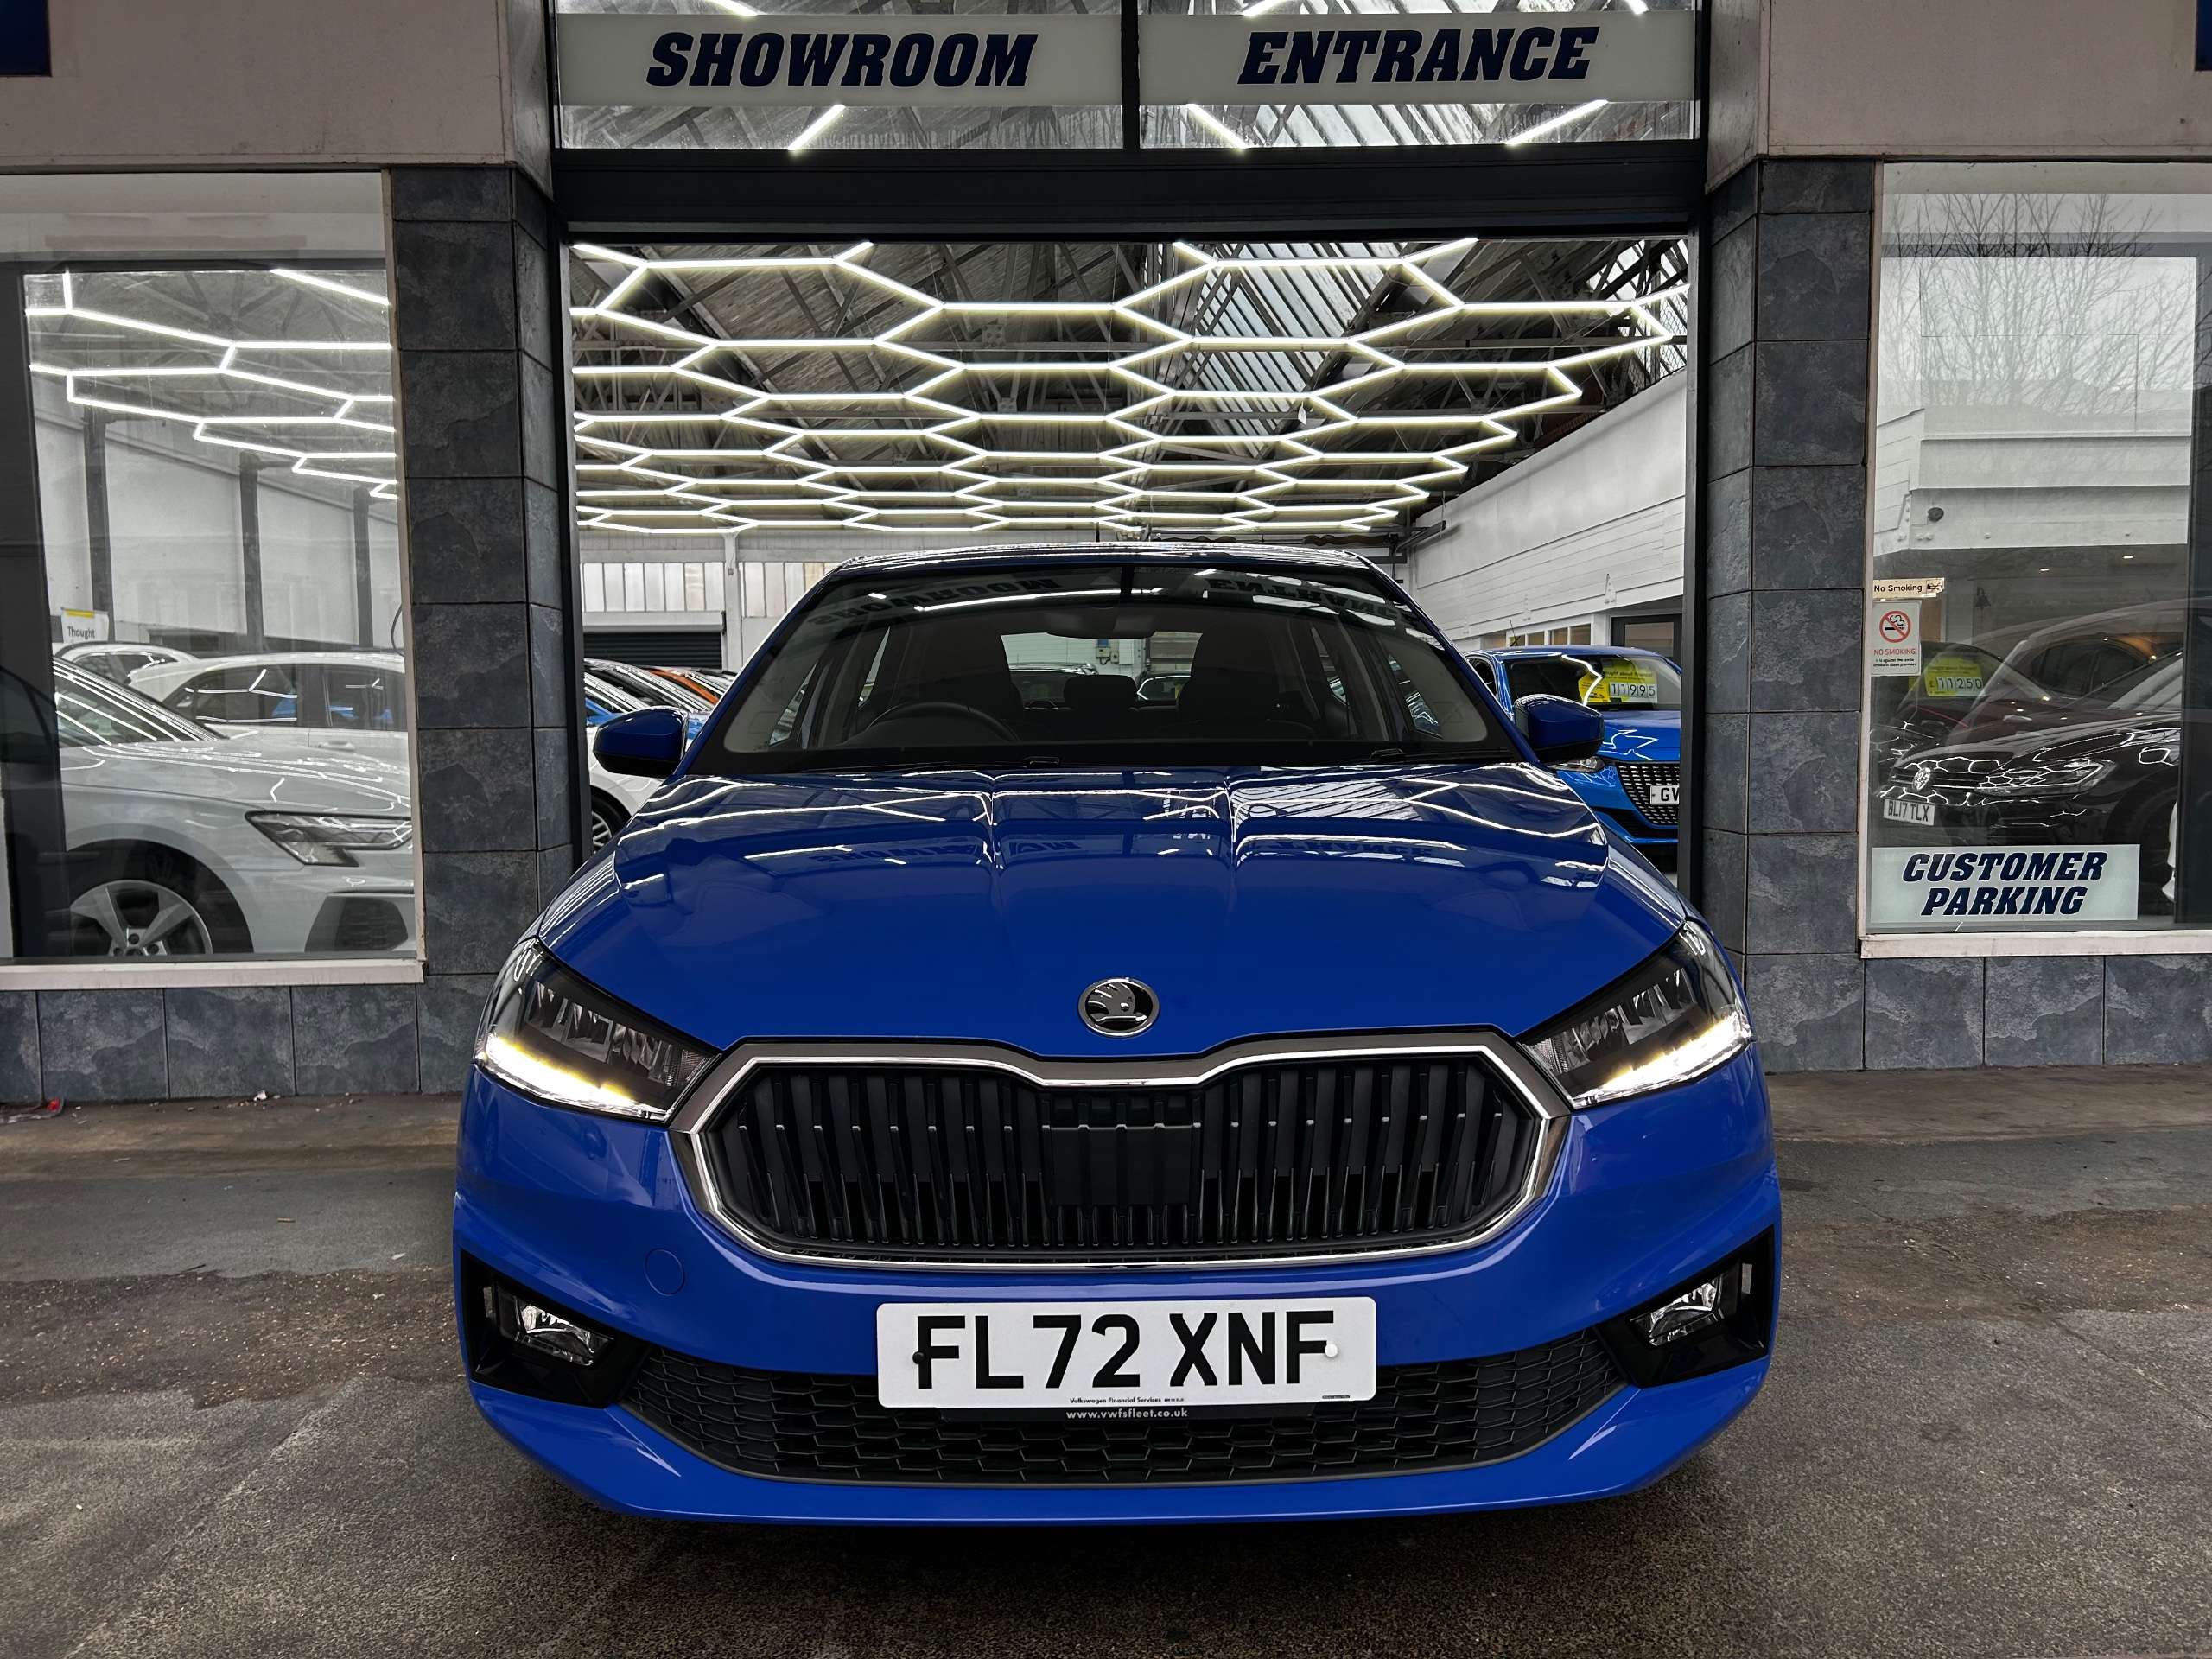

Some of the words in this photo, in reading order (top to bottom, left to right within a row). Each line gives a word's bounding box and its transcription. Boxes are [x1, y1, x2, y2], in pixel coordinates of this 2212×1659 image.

[645, 31, 1039, 87] SHOWROOM
[1236, 26, 1600, 85] ENTRANCE
[1888, 584, 1923, 593] Smoking
[67, 626, 95, 639] Thought
[1611, 683, 1656, 697] 11995
[1938, 677, 1982, 690] 11250
[1888, 800, 1908, 818] BL17
[1910, 803, 1929, 822] TLX
[1902, 851, 2109, 882] CUSTOMER
[1920, 886, 2088, 917] PARKING
[917, 1313, 1141, 1389] FL72
[1169, 1310, 1335, 1387] XNF
[1066, 1408, 1188, 1419] www.vwfsfleet.co.uk
